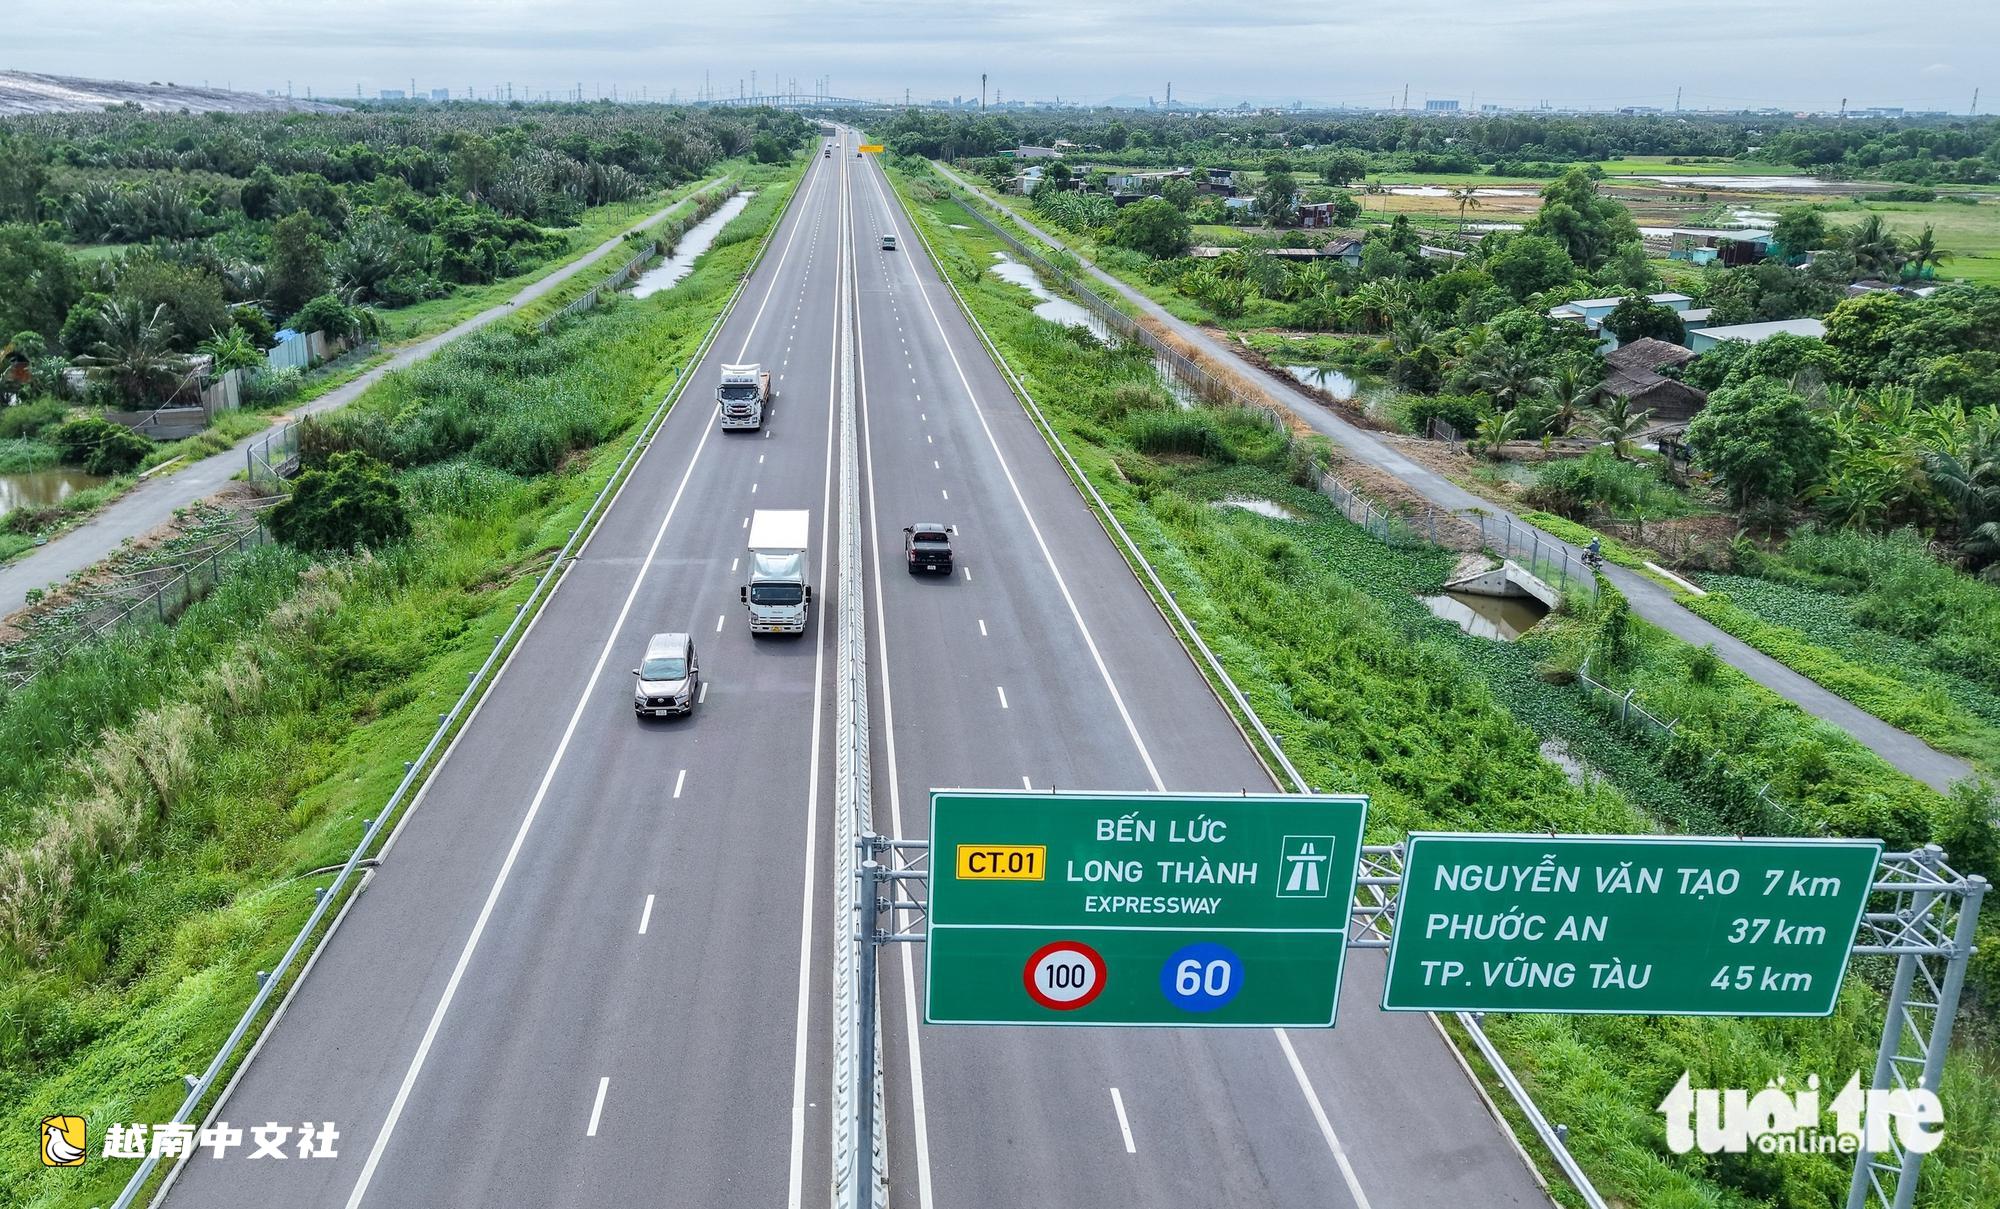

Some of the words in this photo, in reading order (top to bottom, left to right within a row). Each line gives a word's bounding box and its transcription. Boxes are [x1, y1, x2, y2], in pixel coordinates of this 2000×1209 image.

[1096, 811, 1155, 842] BẾN
[1169, 814, 1227, 843] LỨC
[968, 851, 1035, 874] CT.01
[1066, 860, 1143, 882] LONG
[1158, 857, 1258, 884] THÀNH
[1434, 854, 1580, 893] NGUYỄN
[1596, 862, 1664, 894] VĂN
[1677, 869, 1740, 900] TẠO
[1763, 870, 1784, 896] 7
[1788, 871, 1841, 897] km
[1085, 896, 1222, 915] EXPRESSWAY
[1426, 906, 1545, 940] PHƯỚC
[1554, 917, 1608, 942] AN
[1727, 919, 1769, 944] 37
[1774, 919, 1826, 945] km
[1046, 963, 1085, 988] 100
[1175, 958, 1231, 996] 60
[1482, 957, 1575, 989] VŨNG
[1590, 958, 1652, 990] TÀU
[1711, 966, 1753, 991] 45
[1760, 965, 1812, 992] km
